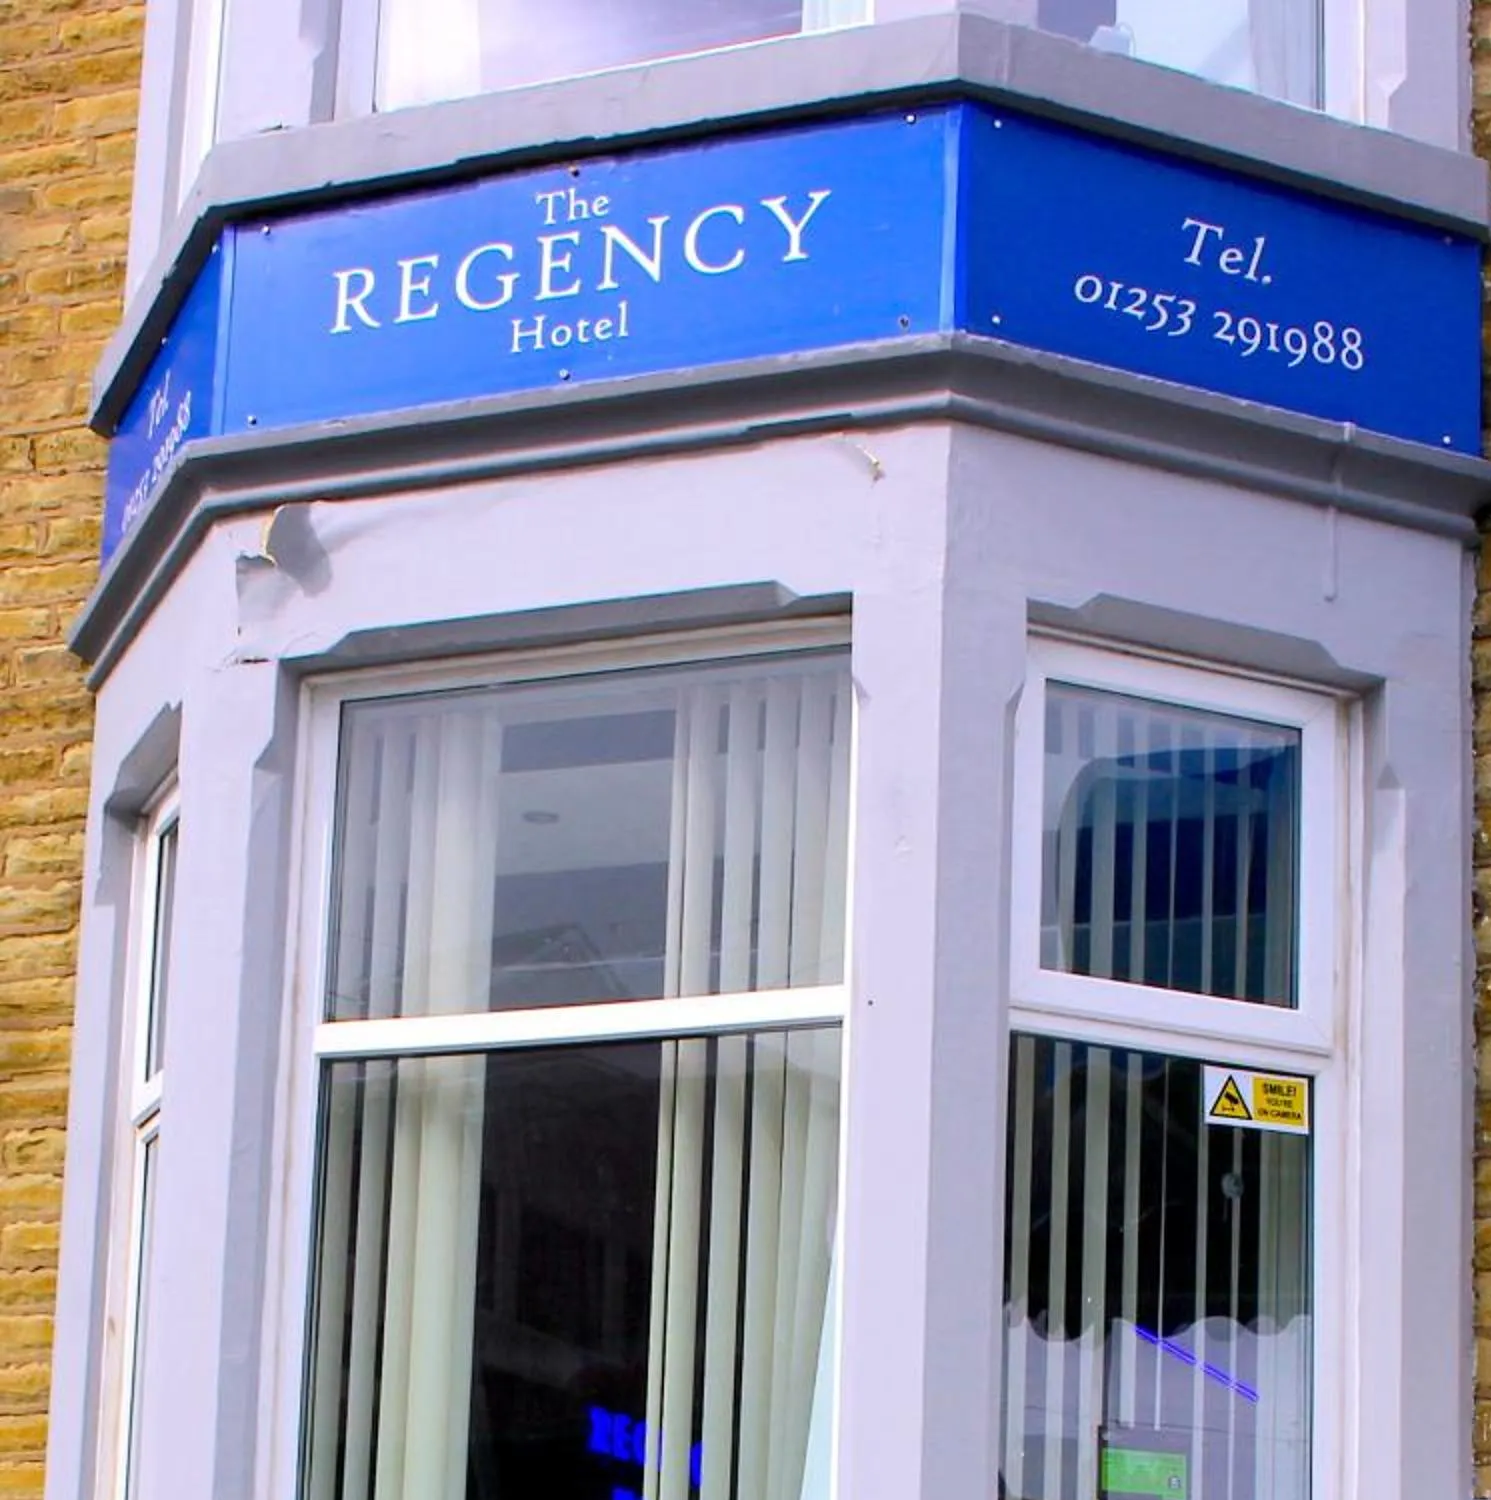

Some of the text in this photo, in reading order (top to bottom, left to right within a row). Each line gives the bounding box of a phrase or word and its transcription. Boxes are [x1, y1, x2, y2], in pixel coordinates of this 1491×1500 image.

[536, 188, 610, 226] The
[330, 189, 831, 334] REGENCY
[1182, 217, 1272, 285] Tel.
[511, 301, 629, 353] Hotel
[1074, 275, 1364, 370] 01253 291988
